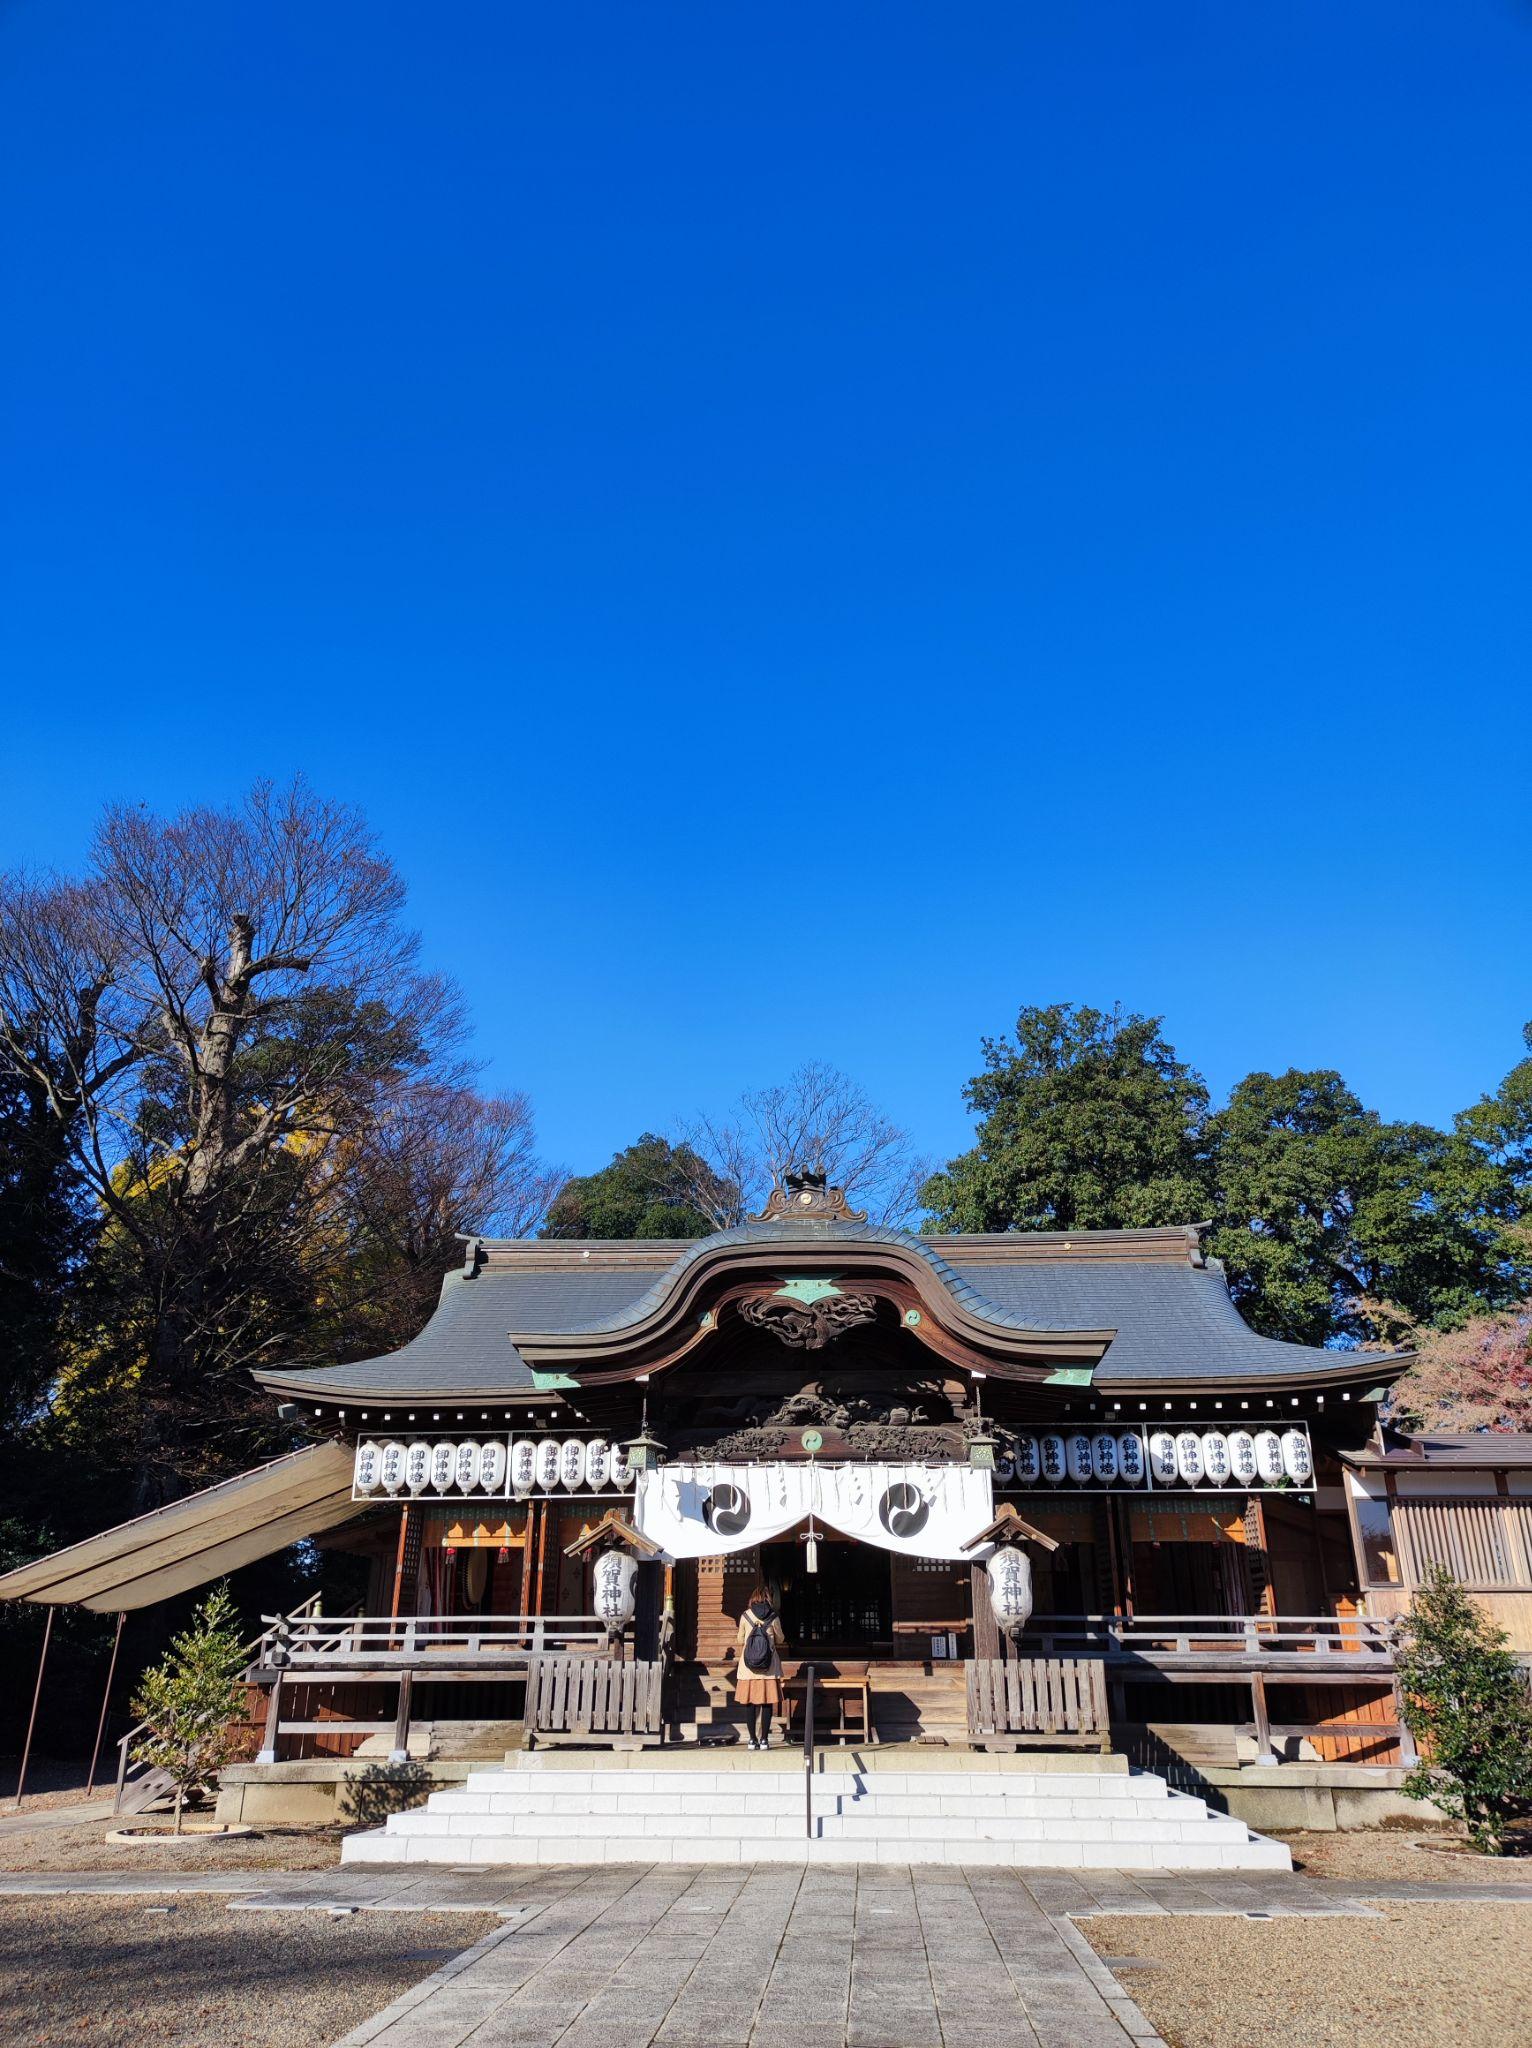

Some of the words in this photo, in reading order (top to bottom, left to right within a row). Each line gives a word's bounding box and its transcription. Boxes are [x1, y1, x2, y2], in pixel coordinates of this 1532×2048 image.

[359, 1450, 374, 1483] 御神燈
[384, 1450, 399, 1481] 御神燈
[410, 1450, 425, 1482] 御神燈
[434, 1450, 449, 1482] 御神燈
[458, 1448, 472, 1481] 御神燈
[482, 1449, 496, 1481] 御神燈
[518, 1446, 532, 1481] 御神燈
[544, 1444, 558, 1480] 御神燈
[564, 1444, 580, 1480] 御神燈
[590, 1444, 604, 1480] 御神燈
[1044, 1438, 1060, 1475] 御神燈
[1076, 1438, 1092, 1475] 御神燈
[1098, 1437, 1114, 1475] 御神燈
[1122, 1437, 1139, 1475] 御神燈
[1160, 1438, 1175, 1474] 御神燈
[1182, 1438, 1199, 1473] 御神燈
[1209, 1438, 1226, 1474] 御神燈
[1237, 1437, 1253, 1473] 御神燈
[1267, 1436, 1281, 1473] 御神燈
[1292, 1436, 1308, 1473] 御神燈
[602, 1552, 623, 1617] 須賀神社
[1000, 1551, 1023, 1616] 須賀神社
